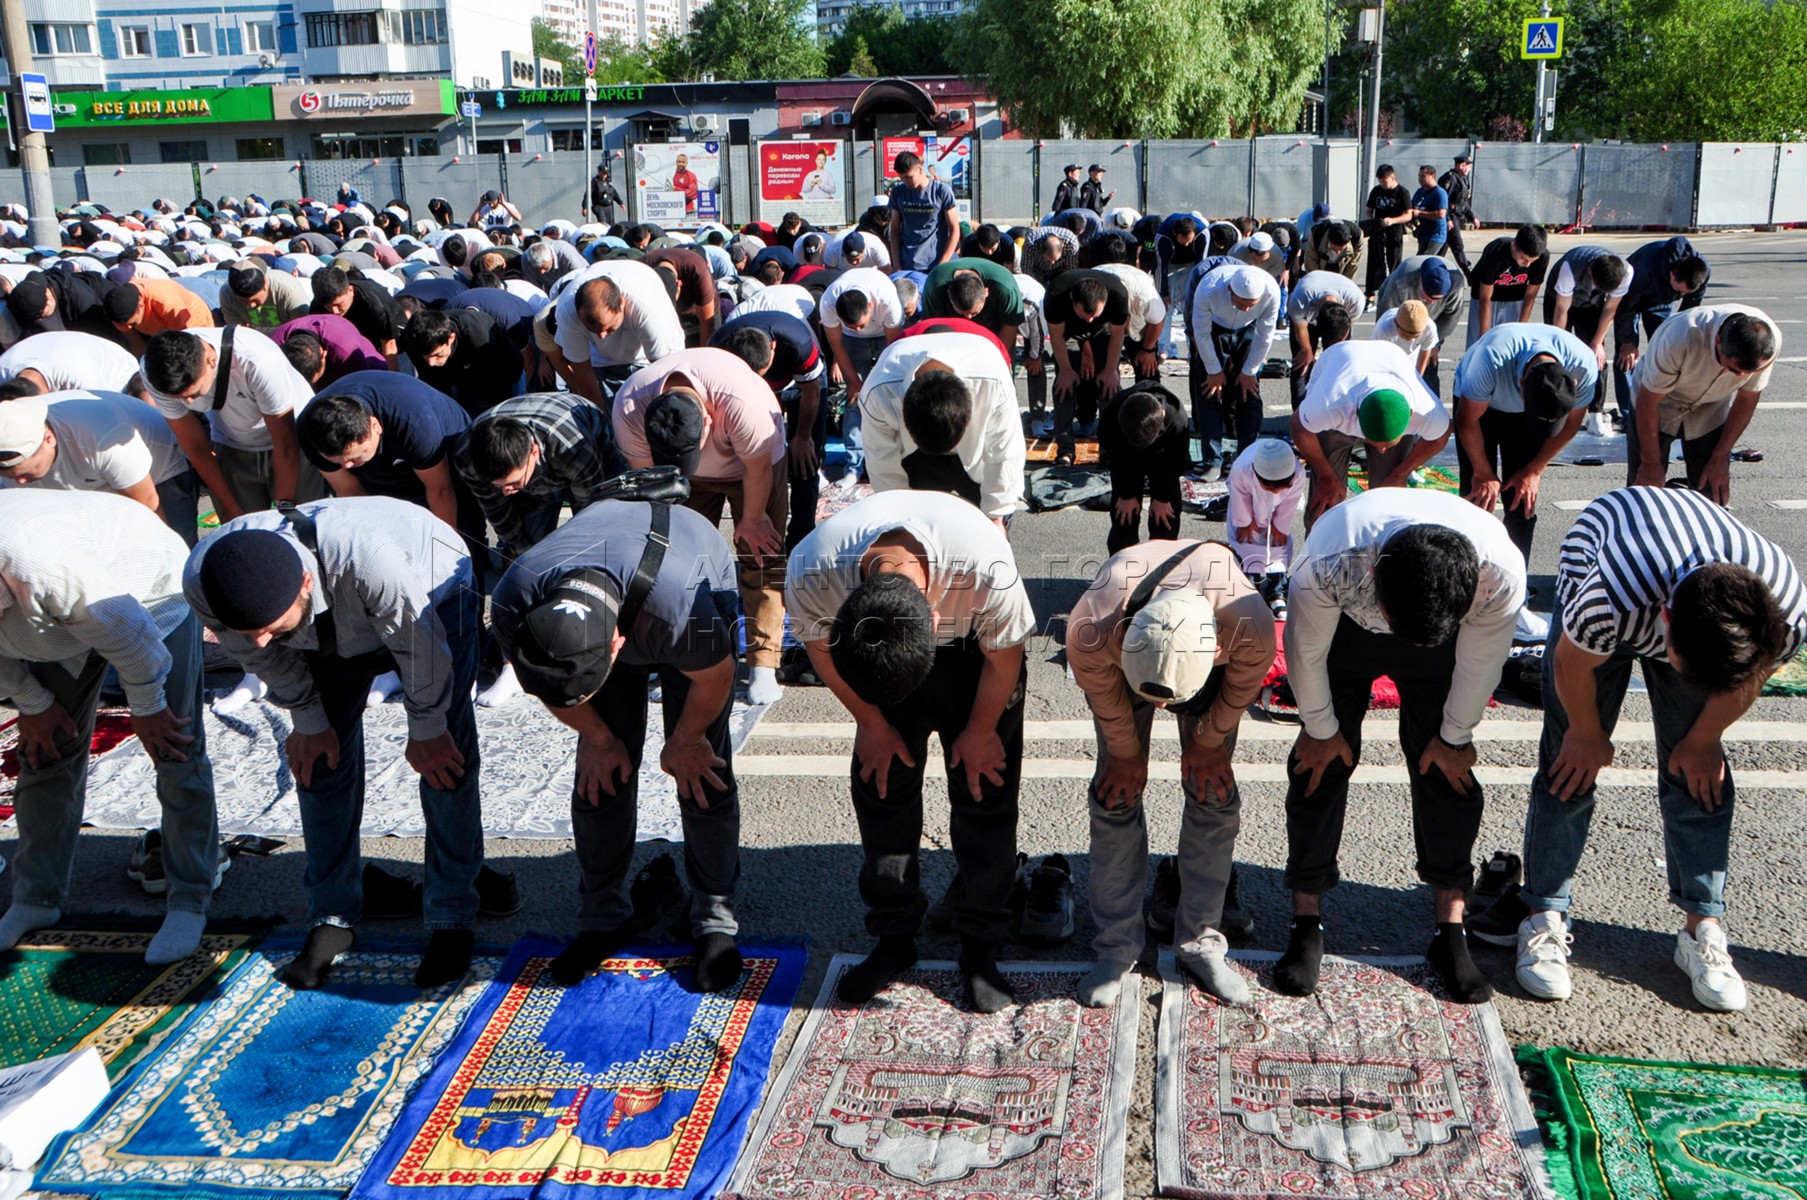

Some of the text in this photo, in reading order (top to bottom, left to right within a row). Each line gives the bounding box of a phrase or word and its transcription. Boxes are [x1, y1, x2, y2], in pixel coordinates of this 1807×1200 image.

[597, 87, 645, 101] АРКЕТ
[93, 98, 210, 115] ВСЕ ДЛЯ ДОМА
[646, 193, 659, 201] ДЕНЬ
[646, 201, 683, 209] МОСКОВСКОГО
[569, 580, 606, 600] adidas
